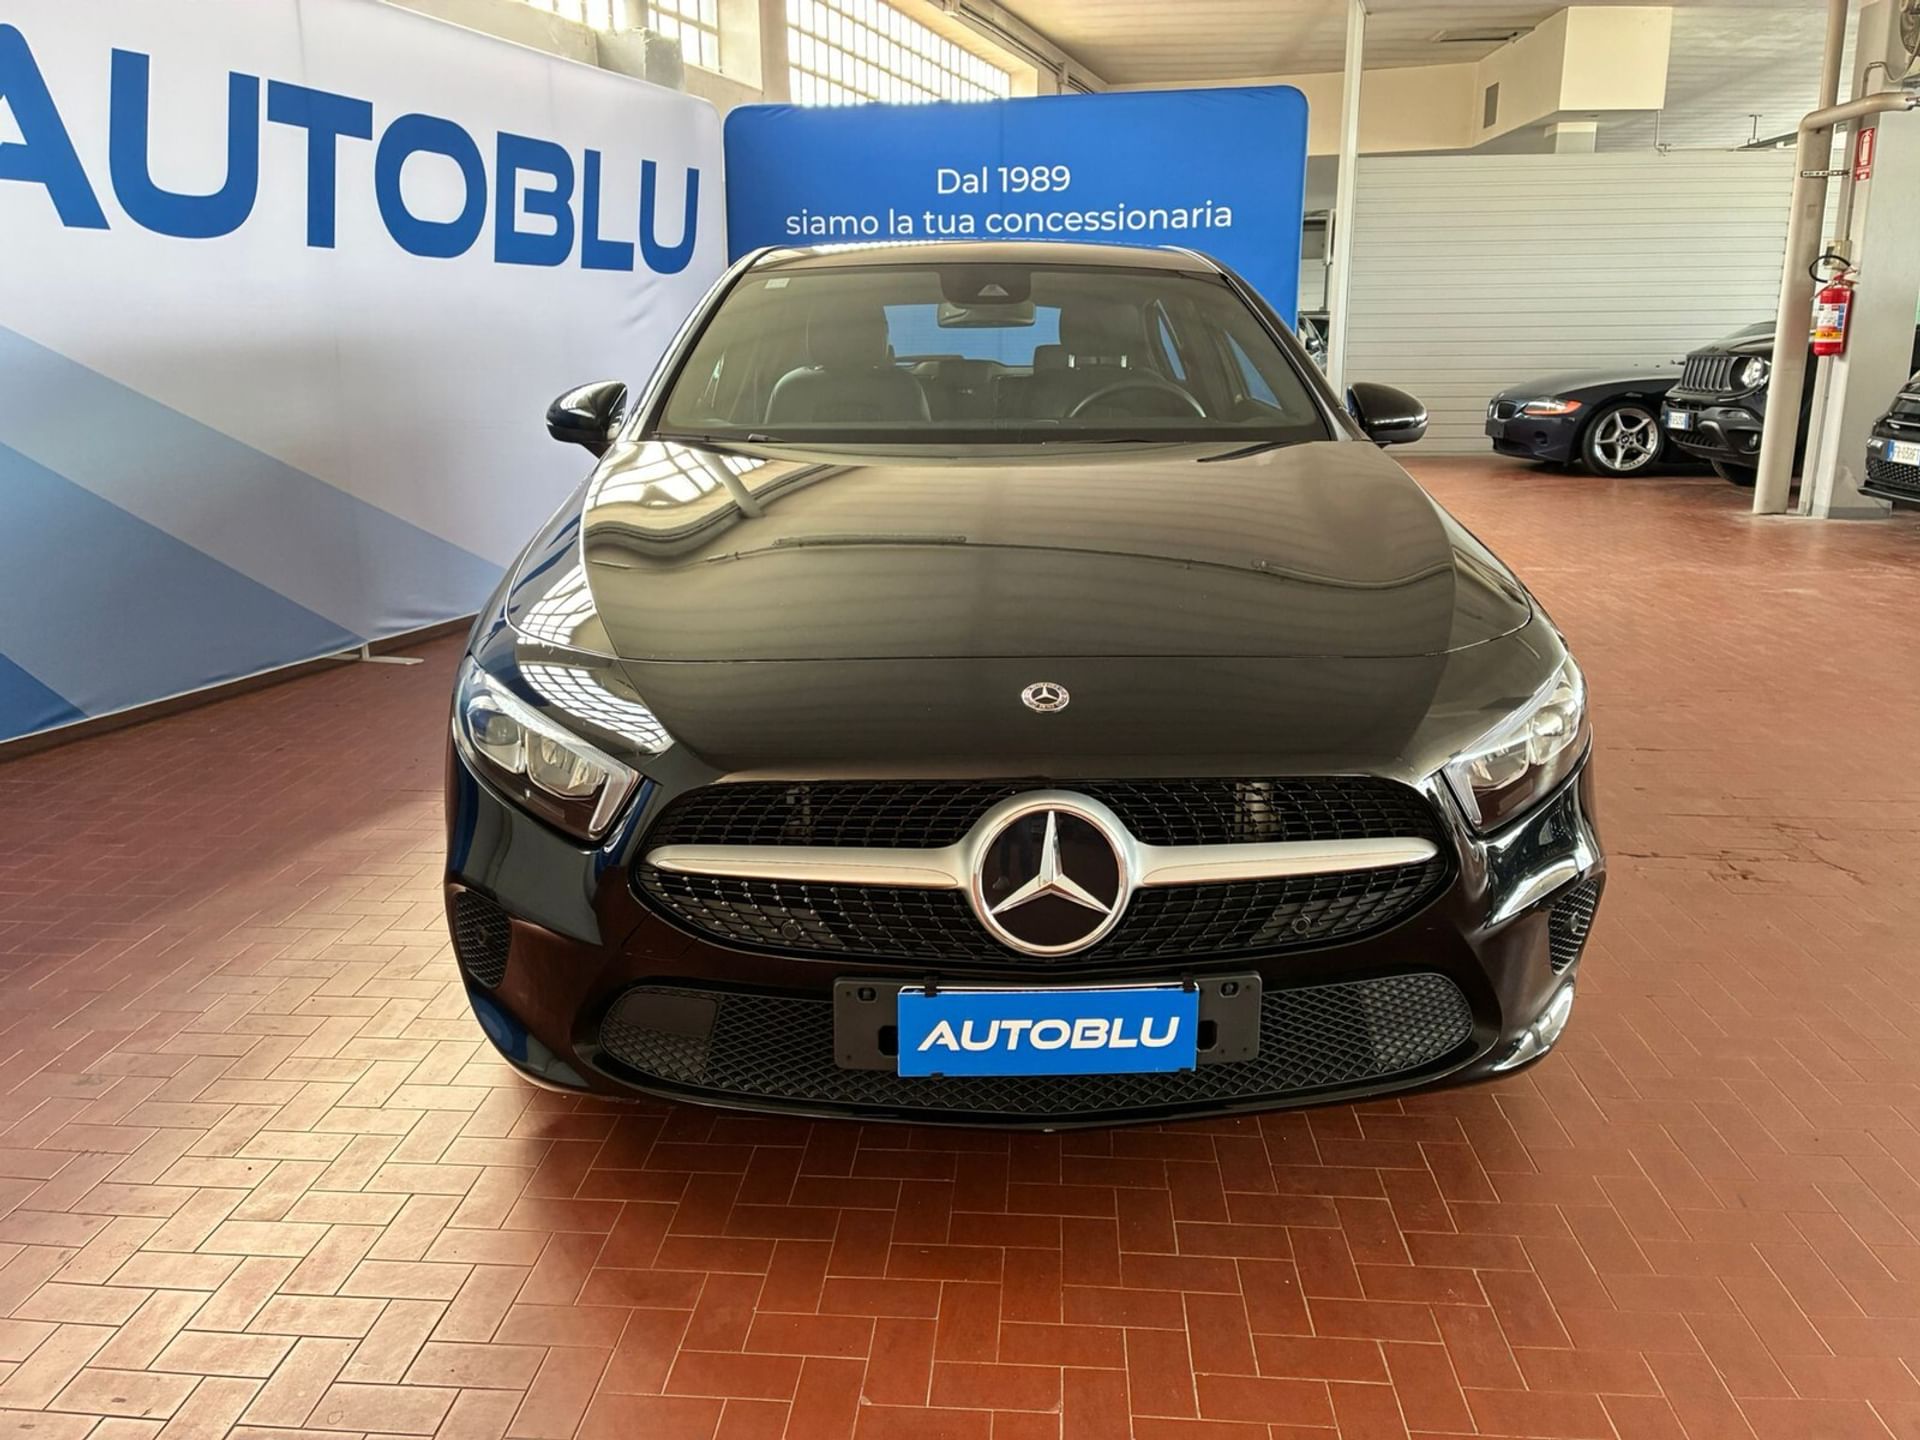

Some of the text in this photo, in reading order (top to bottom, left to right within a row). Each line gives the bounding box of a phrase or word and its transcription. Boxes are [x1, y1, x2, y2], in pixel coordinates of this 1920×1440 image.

[0, 23, 700, 275] AUTOBLU
[937, 165, 1071, 195] Dal 1989
[786, 200, 1232, 236] siamo la tua concessionaria
[917, 1016, 1180, 1052] AUTOBLU
